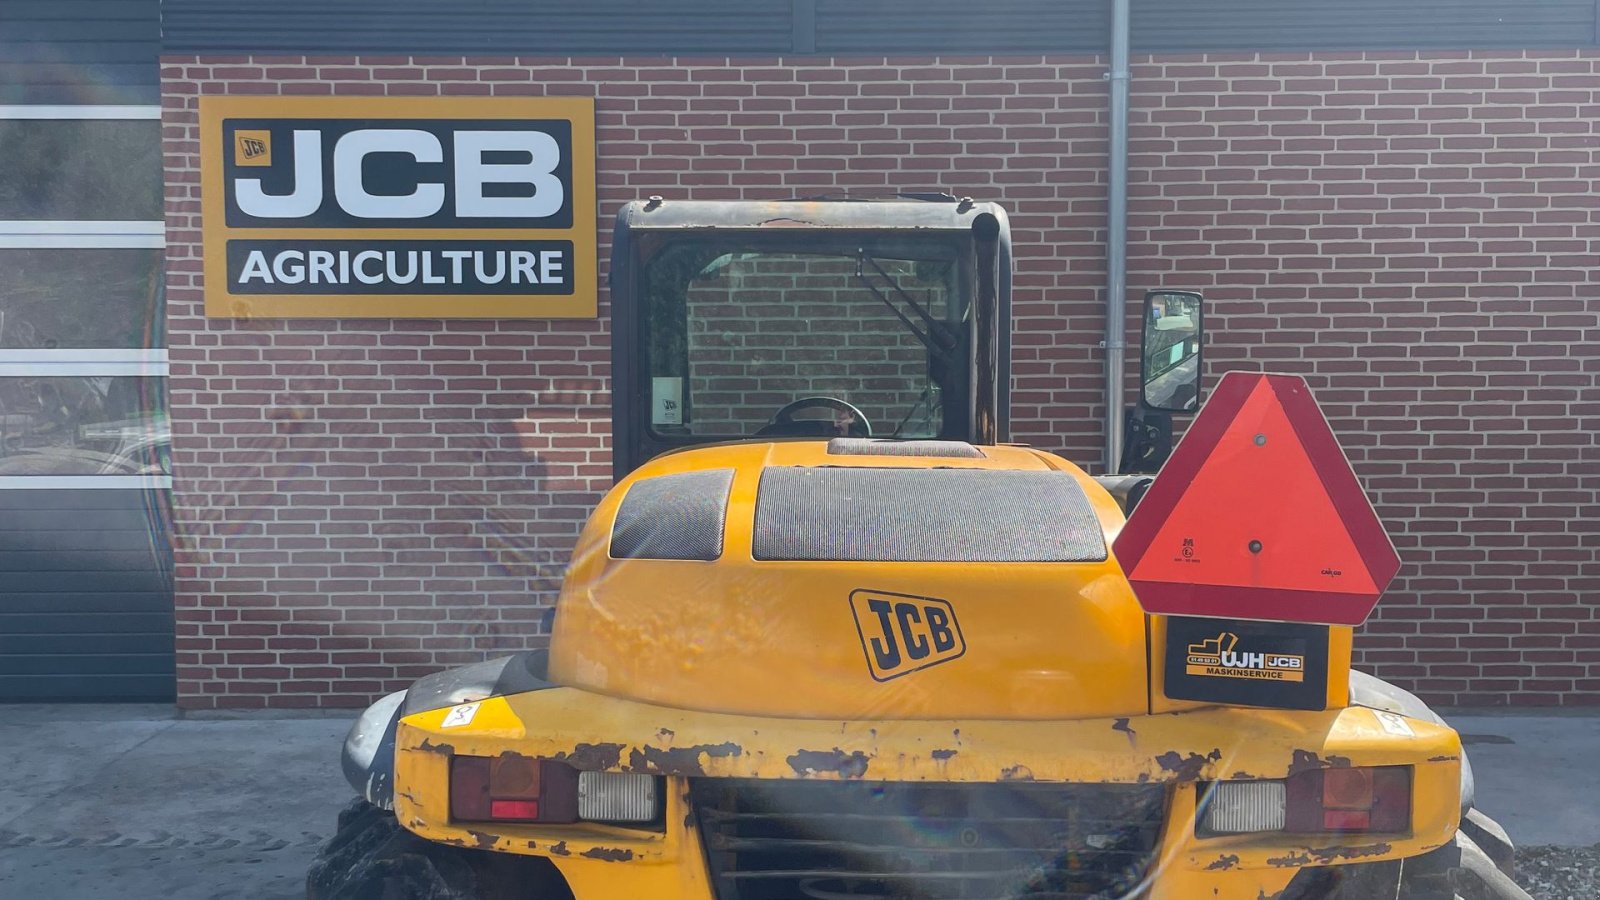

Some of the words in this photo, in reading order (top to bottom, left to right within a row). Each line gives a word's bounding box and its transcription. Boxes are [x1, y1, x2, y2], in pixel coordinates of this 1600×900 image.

[244, 139, 266, 156] JCB
[235, 129, 564, 218] JCB
[238, 250, 564, 284] AGRICULTURE
[867, 599, 956, 670] JCB
[1221, 650, 1265, 669] UJH
[1267, 656, 1301, 668] JCB
[1206, 668, 1284, 679] MASKINSERVICE
